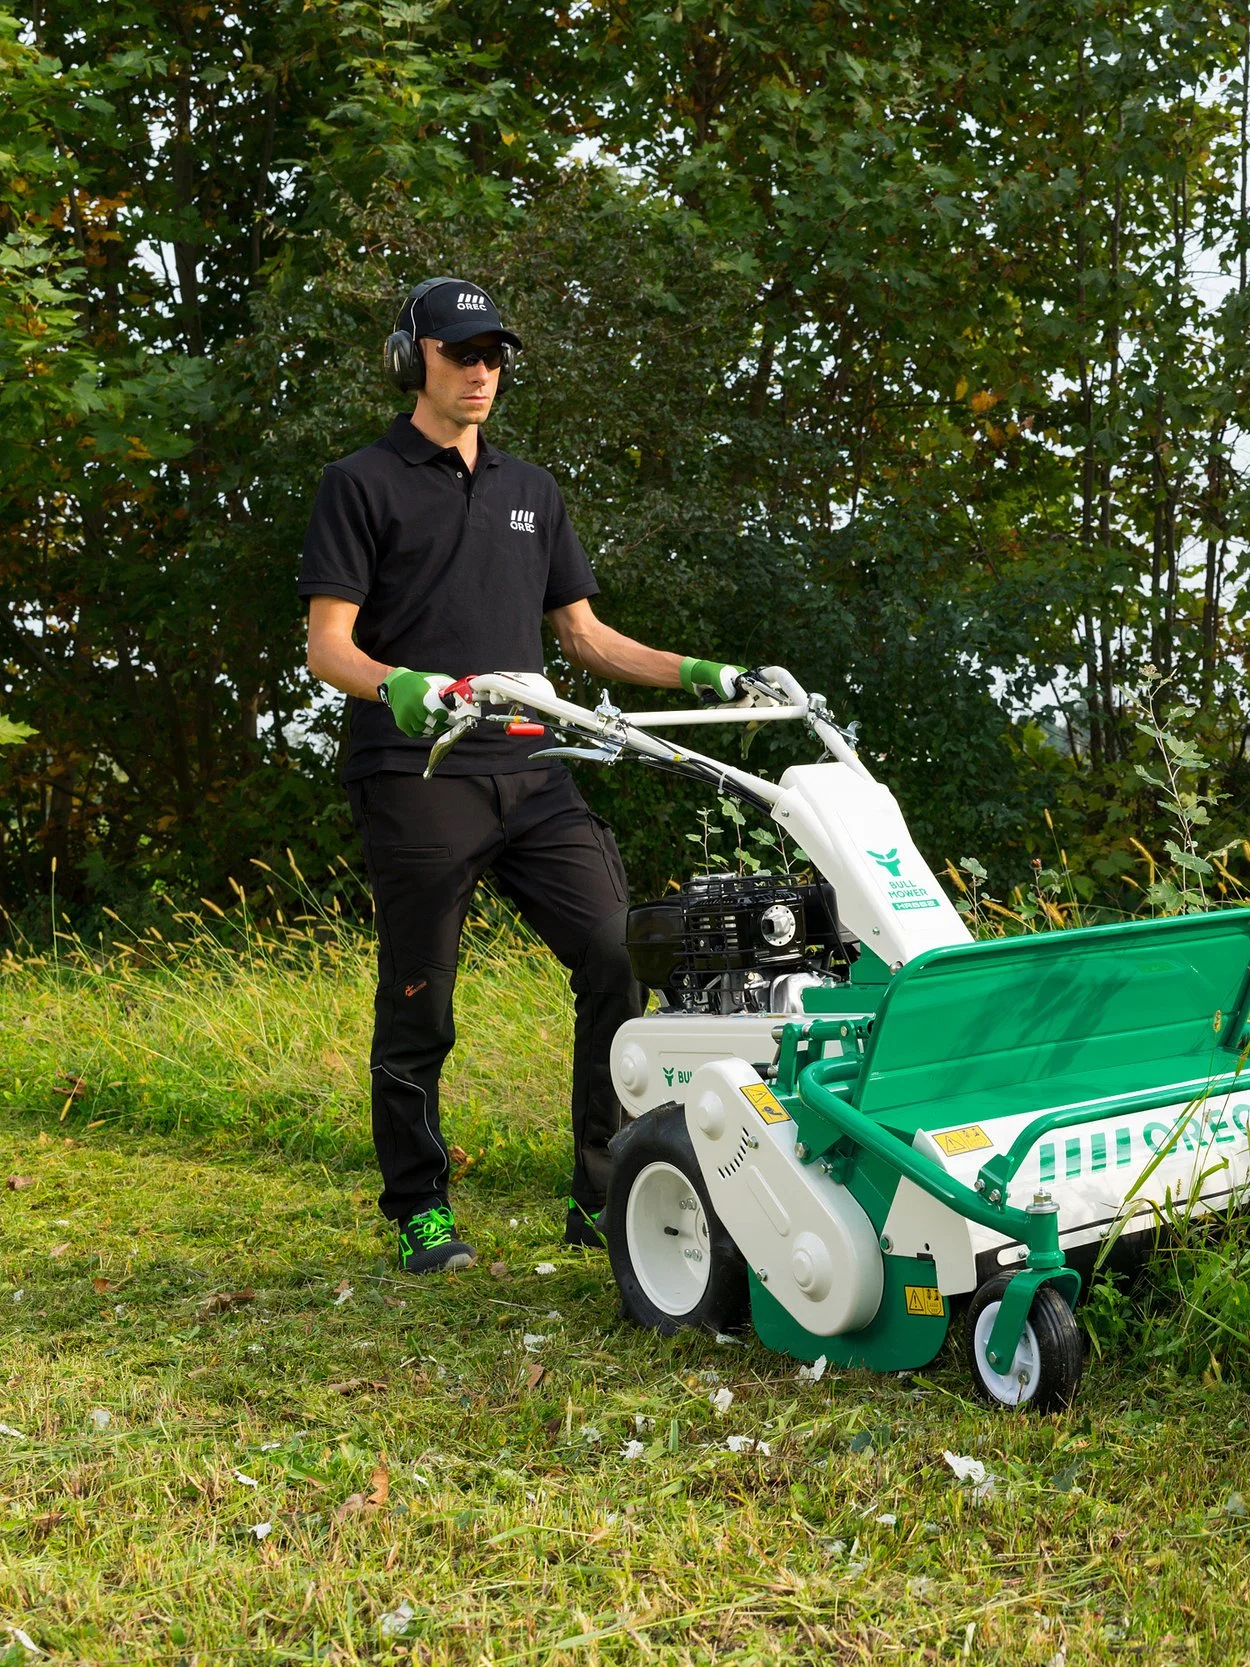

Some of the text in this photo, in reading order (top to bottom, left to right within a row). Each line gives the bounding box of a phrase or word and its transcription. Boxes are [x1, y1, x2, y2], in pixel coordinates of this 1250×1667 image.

[457, 303, 487, 311] OREC
[510, 521, 535, 533] OREC
[889, 880, 917, 889] BULL
[888, 888, 929, 899] MOWER
